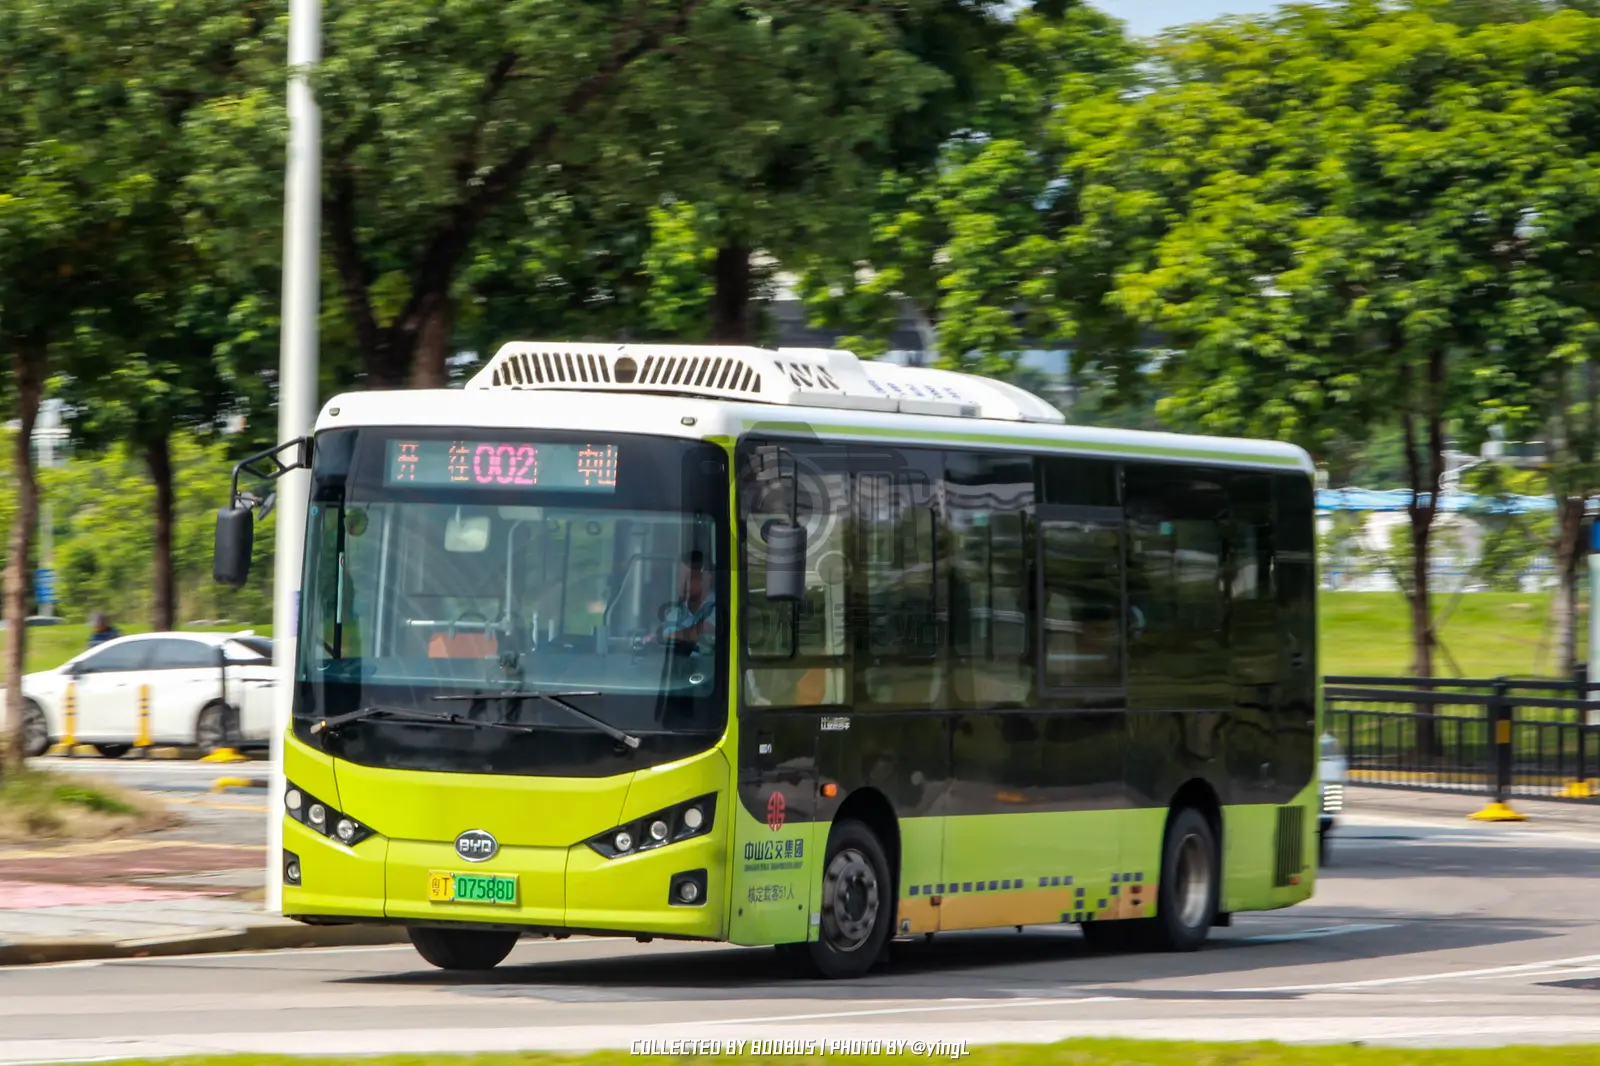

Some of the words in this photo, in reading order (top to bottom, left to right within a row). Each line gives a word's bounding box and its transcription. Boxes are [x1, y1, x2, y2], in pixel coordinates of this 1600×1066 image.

[473, 443, 534, 484] 002
[459, 838, 492, 852] BYD
[744, 838, 804, 861] 中山公交集团
